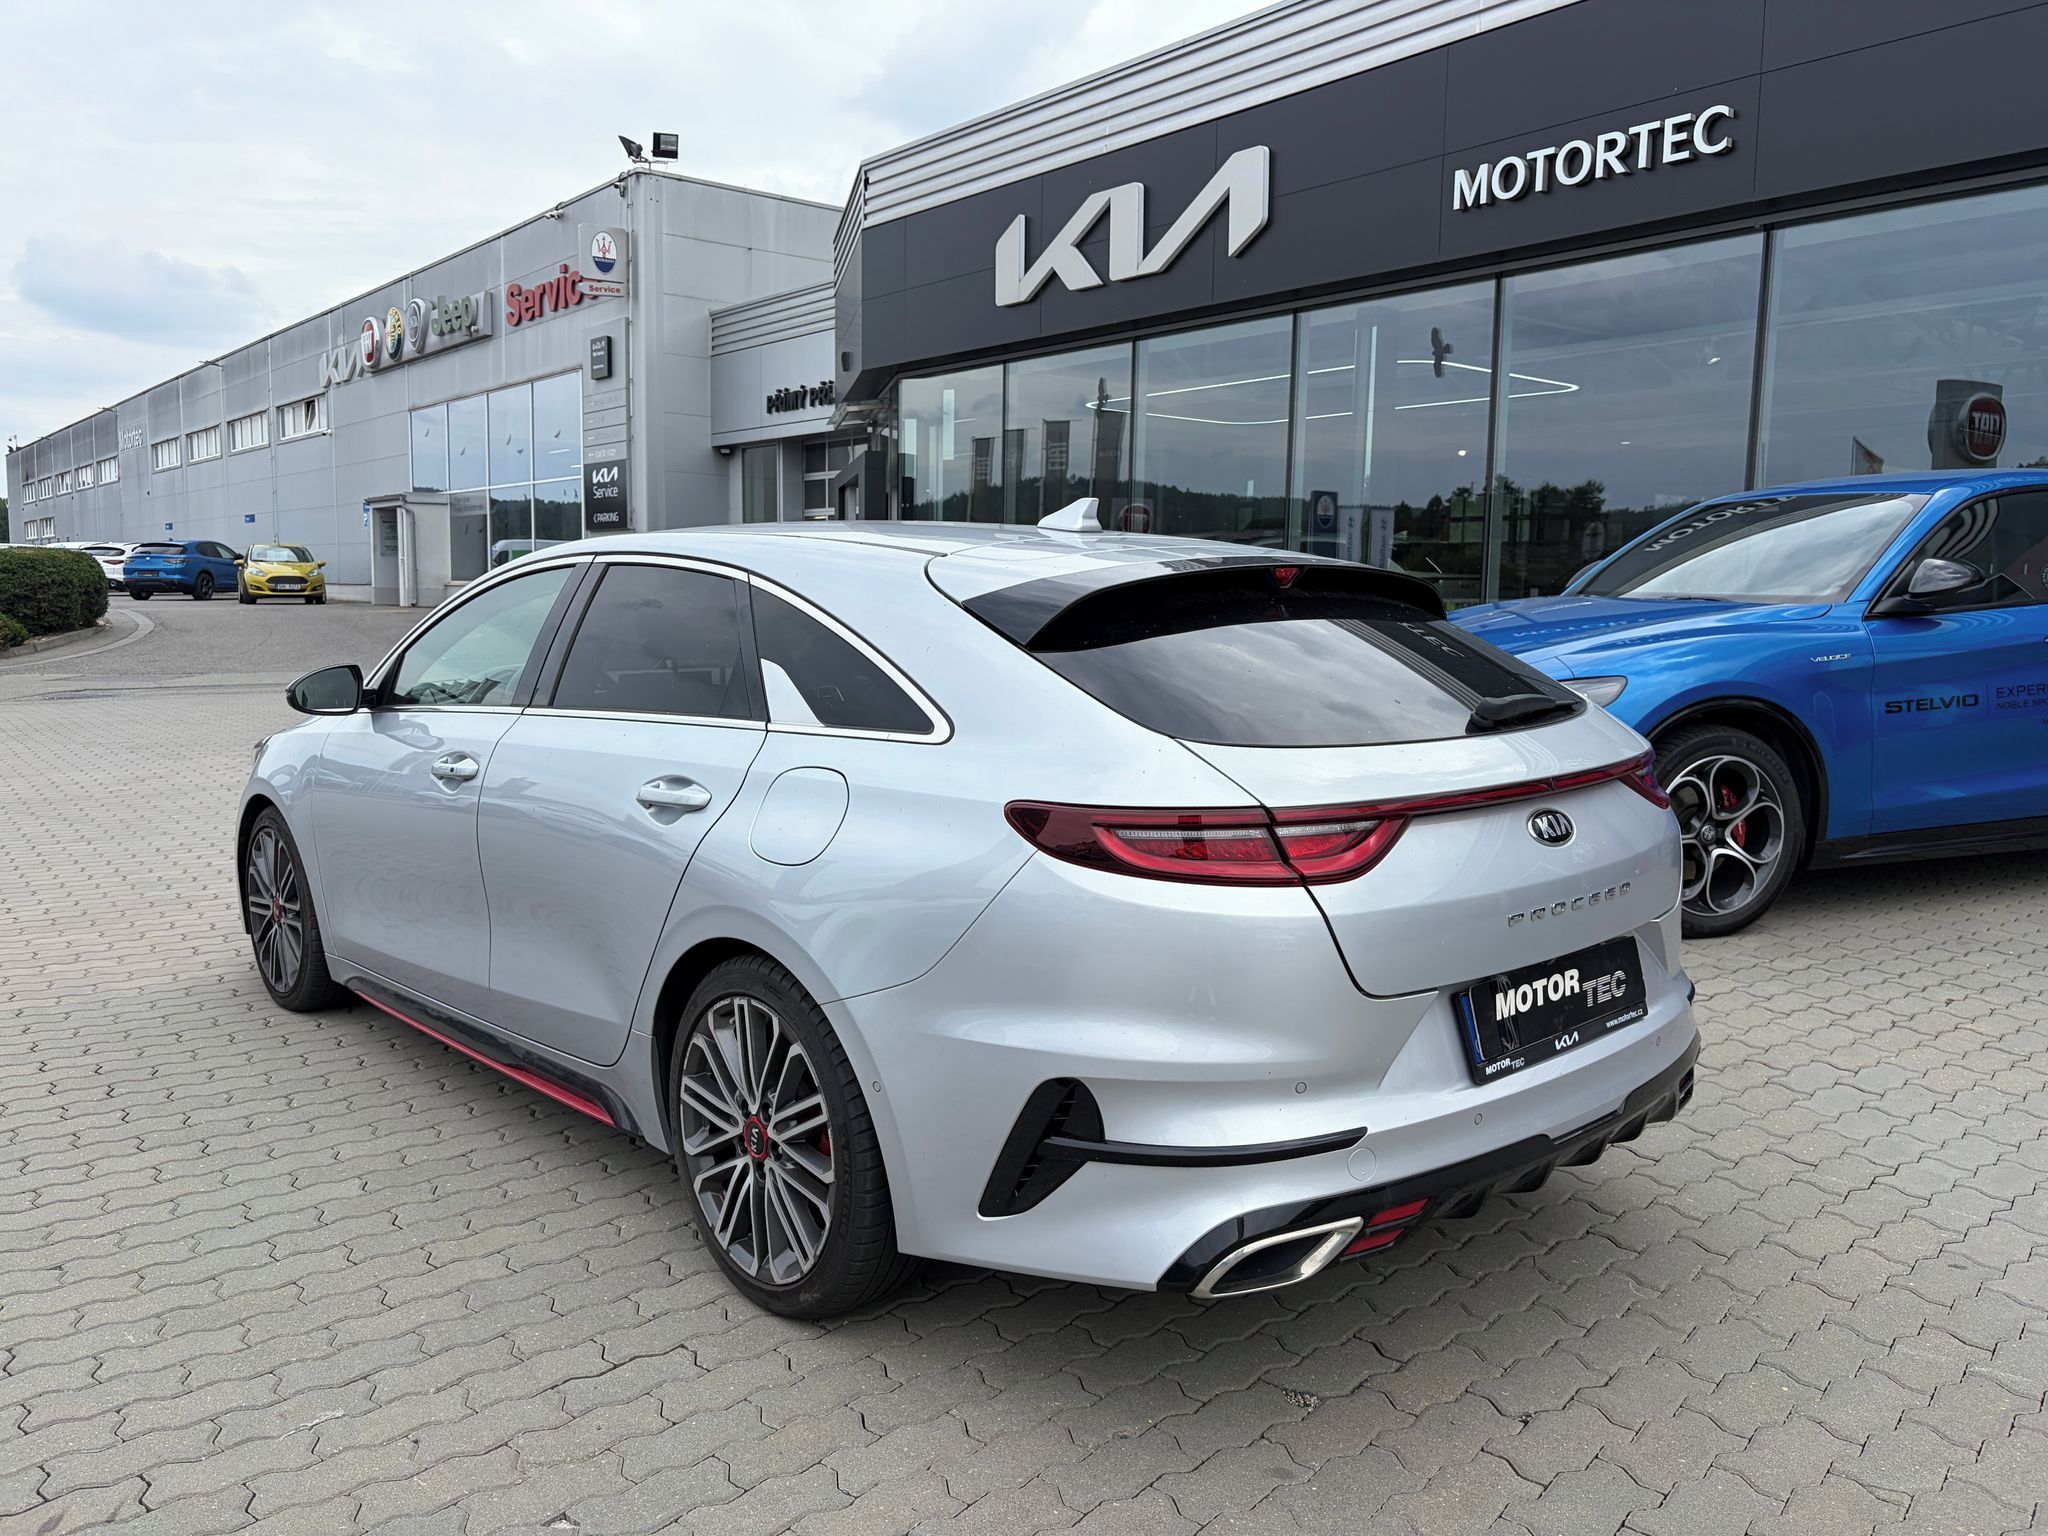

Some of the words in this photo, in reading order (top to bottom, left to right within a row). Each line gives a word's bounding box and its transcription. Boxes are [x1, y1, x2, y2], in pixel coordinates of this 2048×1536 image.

[1453, 104, 1735, 211] MOTORTEC
[995, 144, 1270, 306] KIA
[506, 263, 597, 327] Servic
[588, 284, 621, 294] Service
[431, 295, 473, 337] Jeep
[592, 466, 619, 484] KIA
[593, 484, 619, 499] Service
[598, 511, 620, 523] PARKING
[1884, 694, 1979, 714] STELVIO
[1996, 700, 2029, 710] NOBLE
[1535, 813, 1572, 839] KIA
[1507, 882, 1631, 928] PROCEED
[1495, 968, 1580, 1021] MOTOR
[1582, 970, 1626, 1008] TEC
[1605, 1008, 1643, 1028] www.motortec.cz
[1554, 1030, 1580, 1050] KIA
[1485, 1057, 1511, 1075] MOTOR
[1511, 1056, 1525, 1070] TEC
